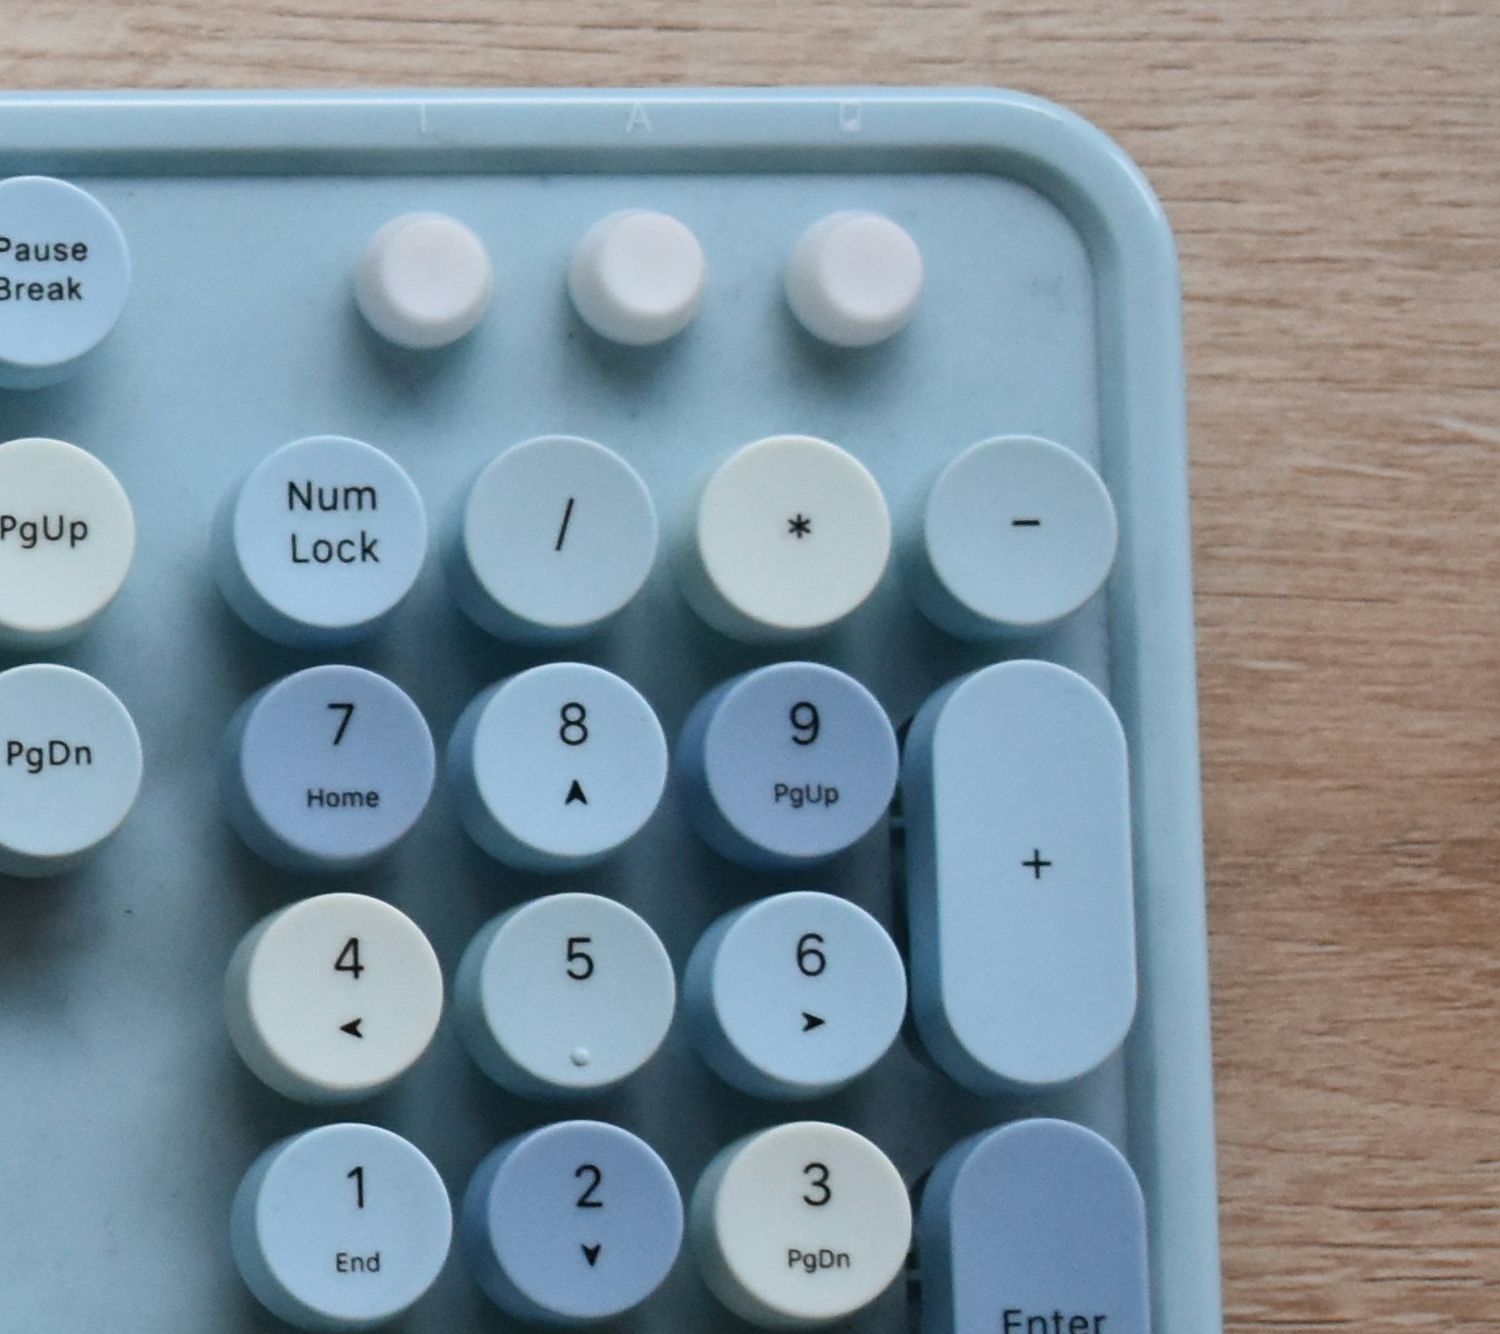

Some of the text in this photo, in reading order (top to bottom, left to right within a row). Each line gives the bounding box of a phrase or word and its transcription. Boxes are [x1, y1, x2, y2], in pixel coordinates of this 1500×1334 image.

[288, 481, 377, 512] Num
[0, 515, 88, 549] PgUp
[555, 498, 574, 551] /
[291, 531, 379, 564] Lock
[327, 702, 355, 746] 7
[559, 702, 589, 746] 8
[789, 701, 820, 746] 9
[7, 740, 92, 774] PgDn
[307, 789, 379, 808] Home
[774, 783, 839, 809] PgUp
[1022, 849, 1051, 879] +
[334, 937, 364, 979] 4
[567, 937, 594, 981] 5
[796, 933, 826, 977] 6
[347, 1166, 364, 1209] 1
[575, 1164, 603, 1209] 2
[803, 1162, 832, 1207] 3
[336, 1253, 380, 1273] End
[788, 1249, 850, 1274] PgDn
